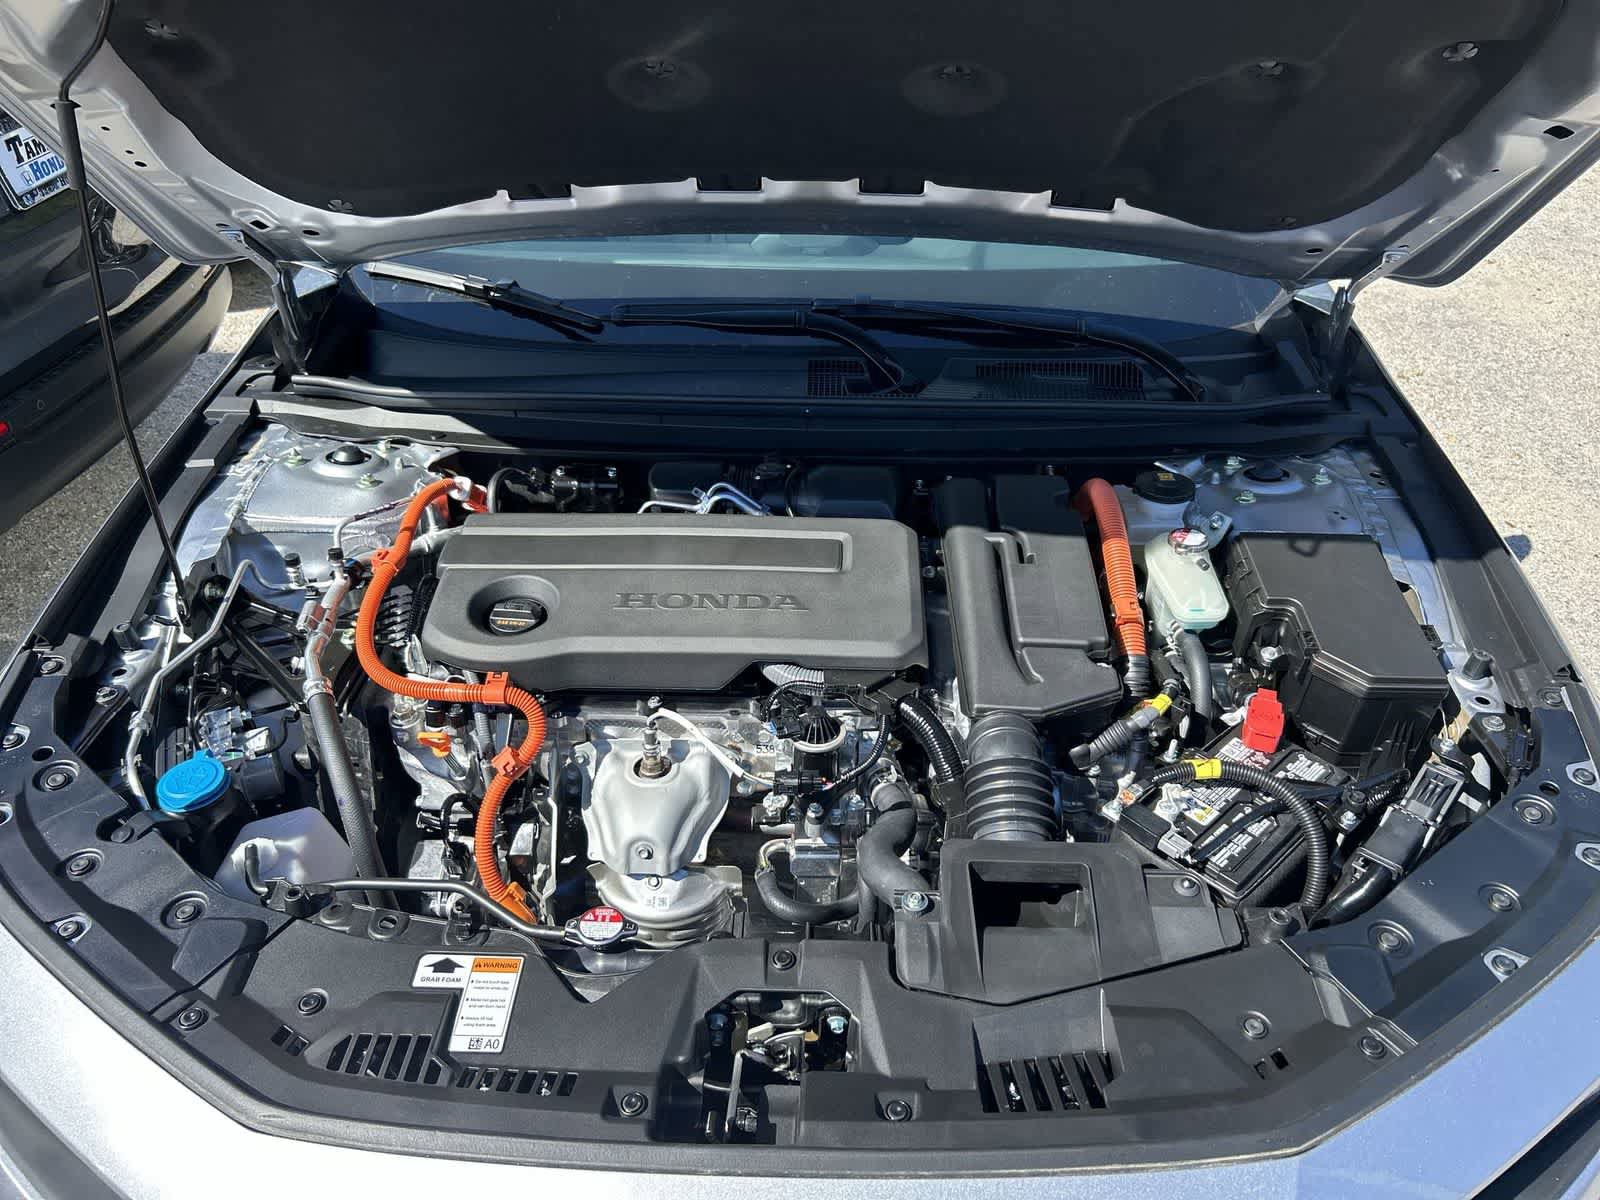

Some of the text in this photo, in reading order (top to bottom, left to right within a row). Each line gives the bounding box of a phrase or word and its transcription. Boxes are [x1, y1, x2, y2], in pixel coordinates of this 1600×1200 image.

[4, 134, 49, 164] TAM
[613, 592, 809, 612] HONDA
[483, 961, 519, 969] WARNING
